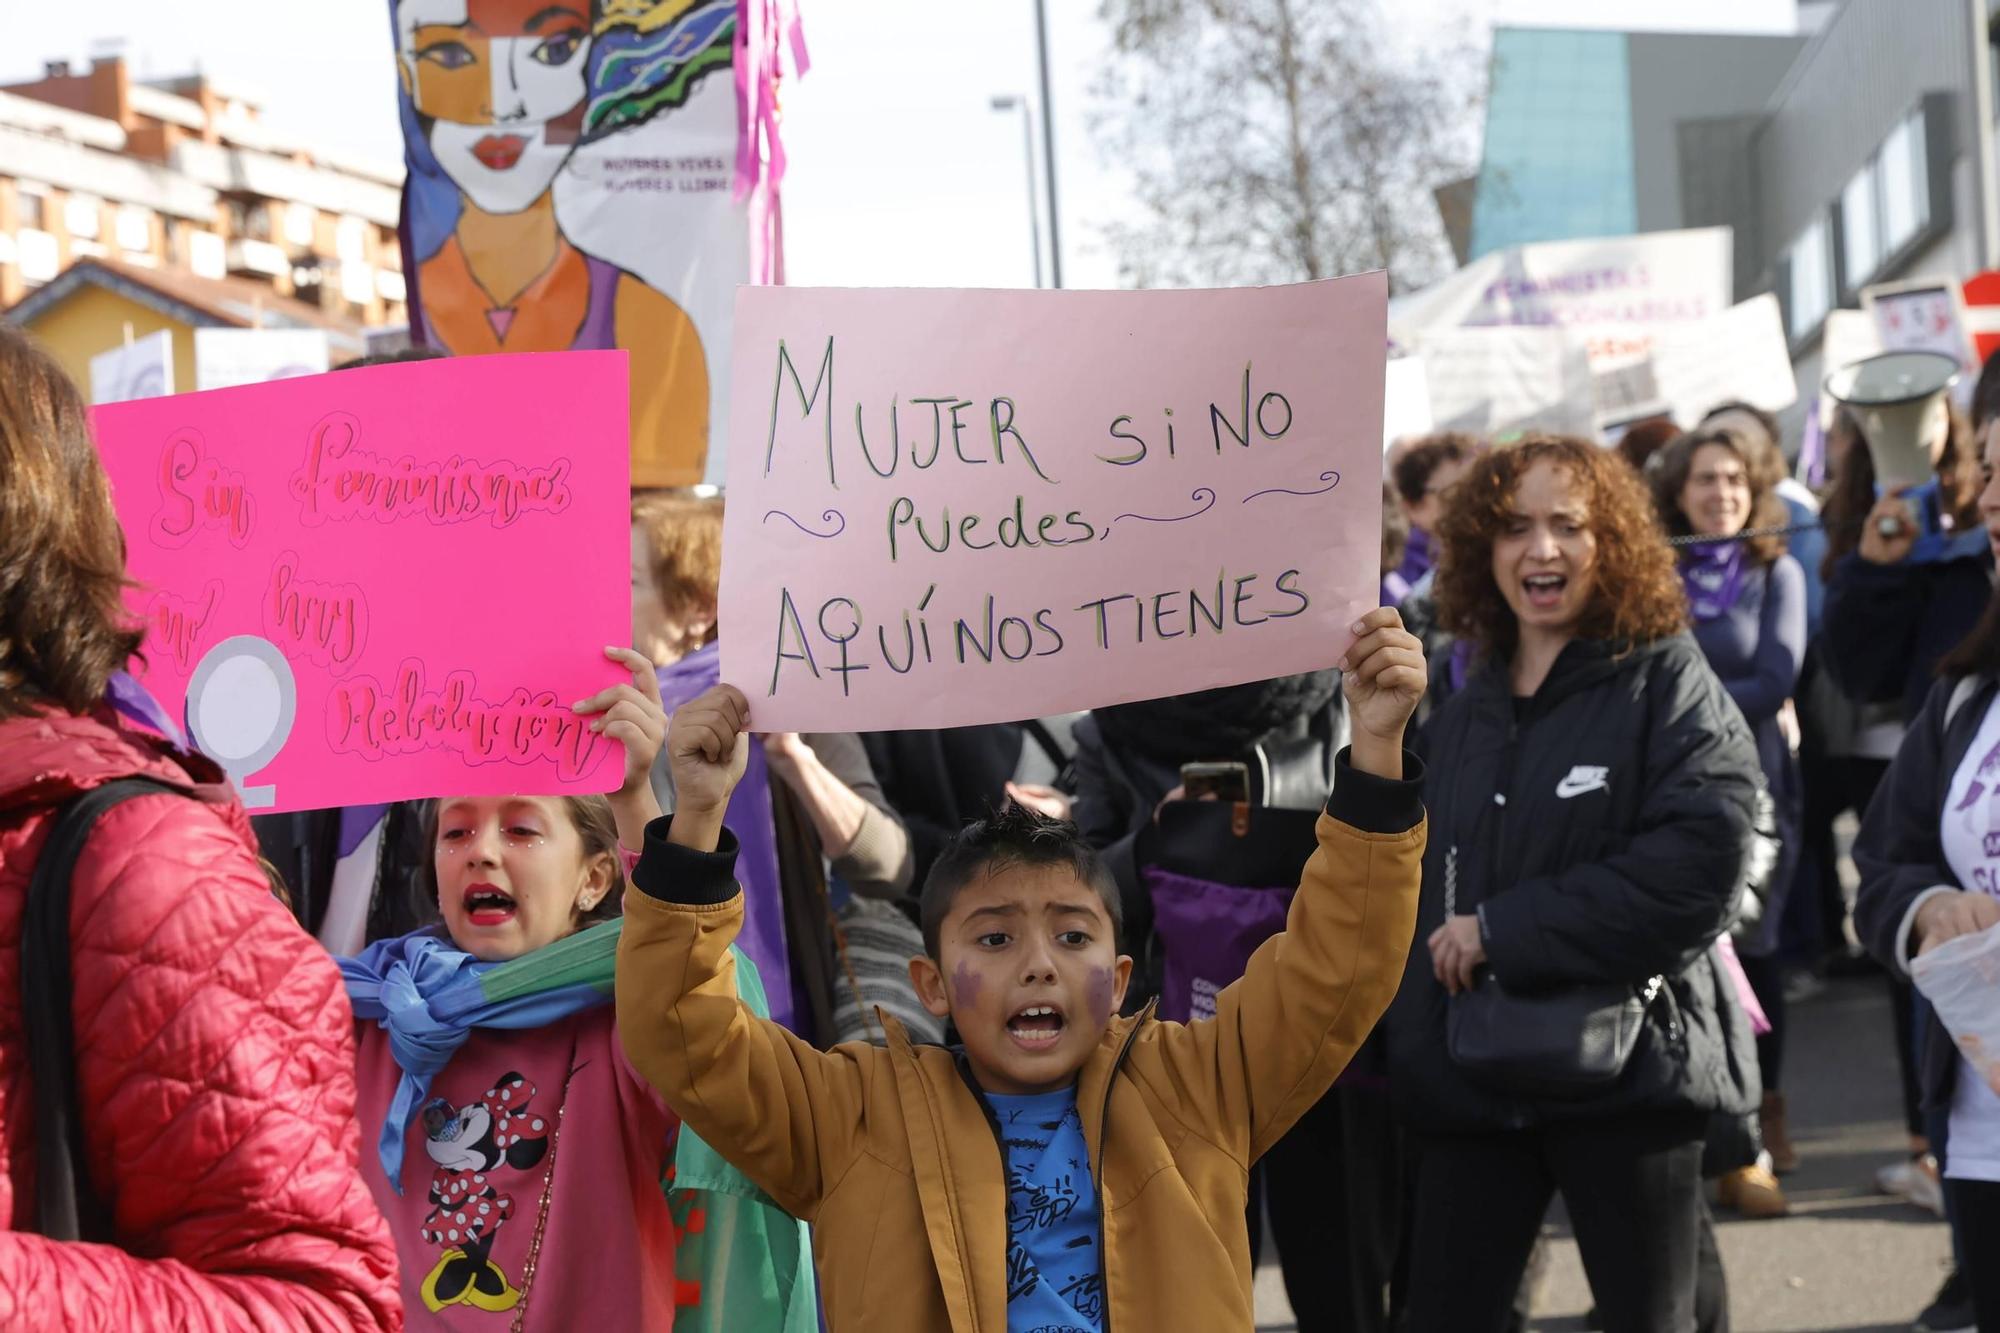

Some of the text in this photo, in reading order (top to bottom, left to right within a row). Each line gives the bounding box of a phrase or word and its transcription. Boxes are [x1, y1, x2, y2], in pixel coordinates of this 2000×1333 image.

[763, 335, 1060, 490] MUJER
[1210, 360, 1292, 455] NO
[160, 439, 249, 540] Sin
[954, 592, 1064, 663] NOS
[1074, 566, 1310, 650] TIENES
